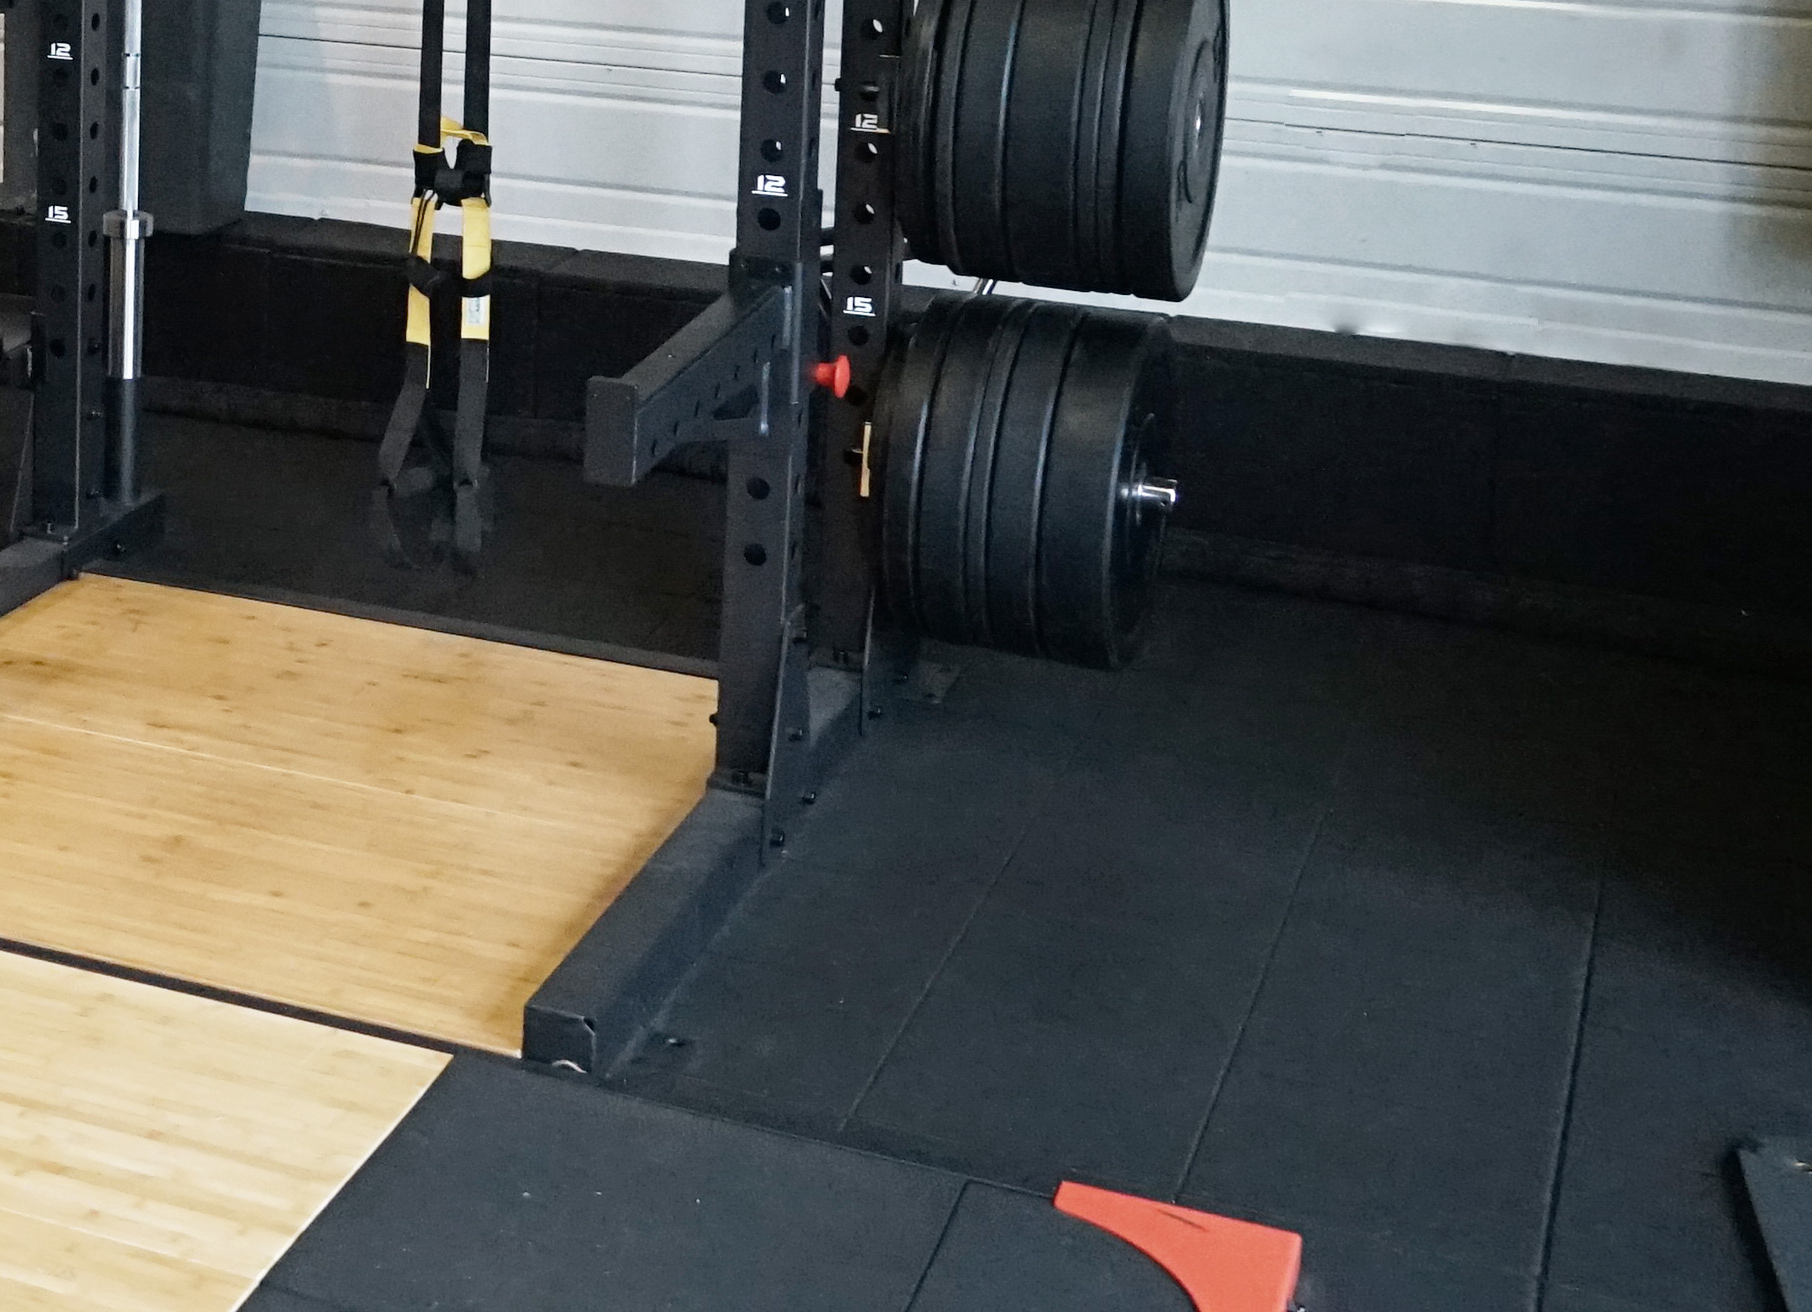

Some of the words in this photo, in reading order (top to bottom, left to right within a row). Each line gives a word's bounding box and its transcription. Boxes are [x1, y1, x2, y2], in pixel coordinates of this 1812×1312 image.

[50, 43, 71, 57] 12
[855, 113, 879, 129] 12
[757, 175, 786, 193] 12
[48, 205, 69, 220] 15
[847, 296, 873, 312] 15
